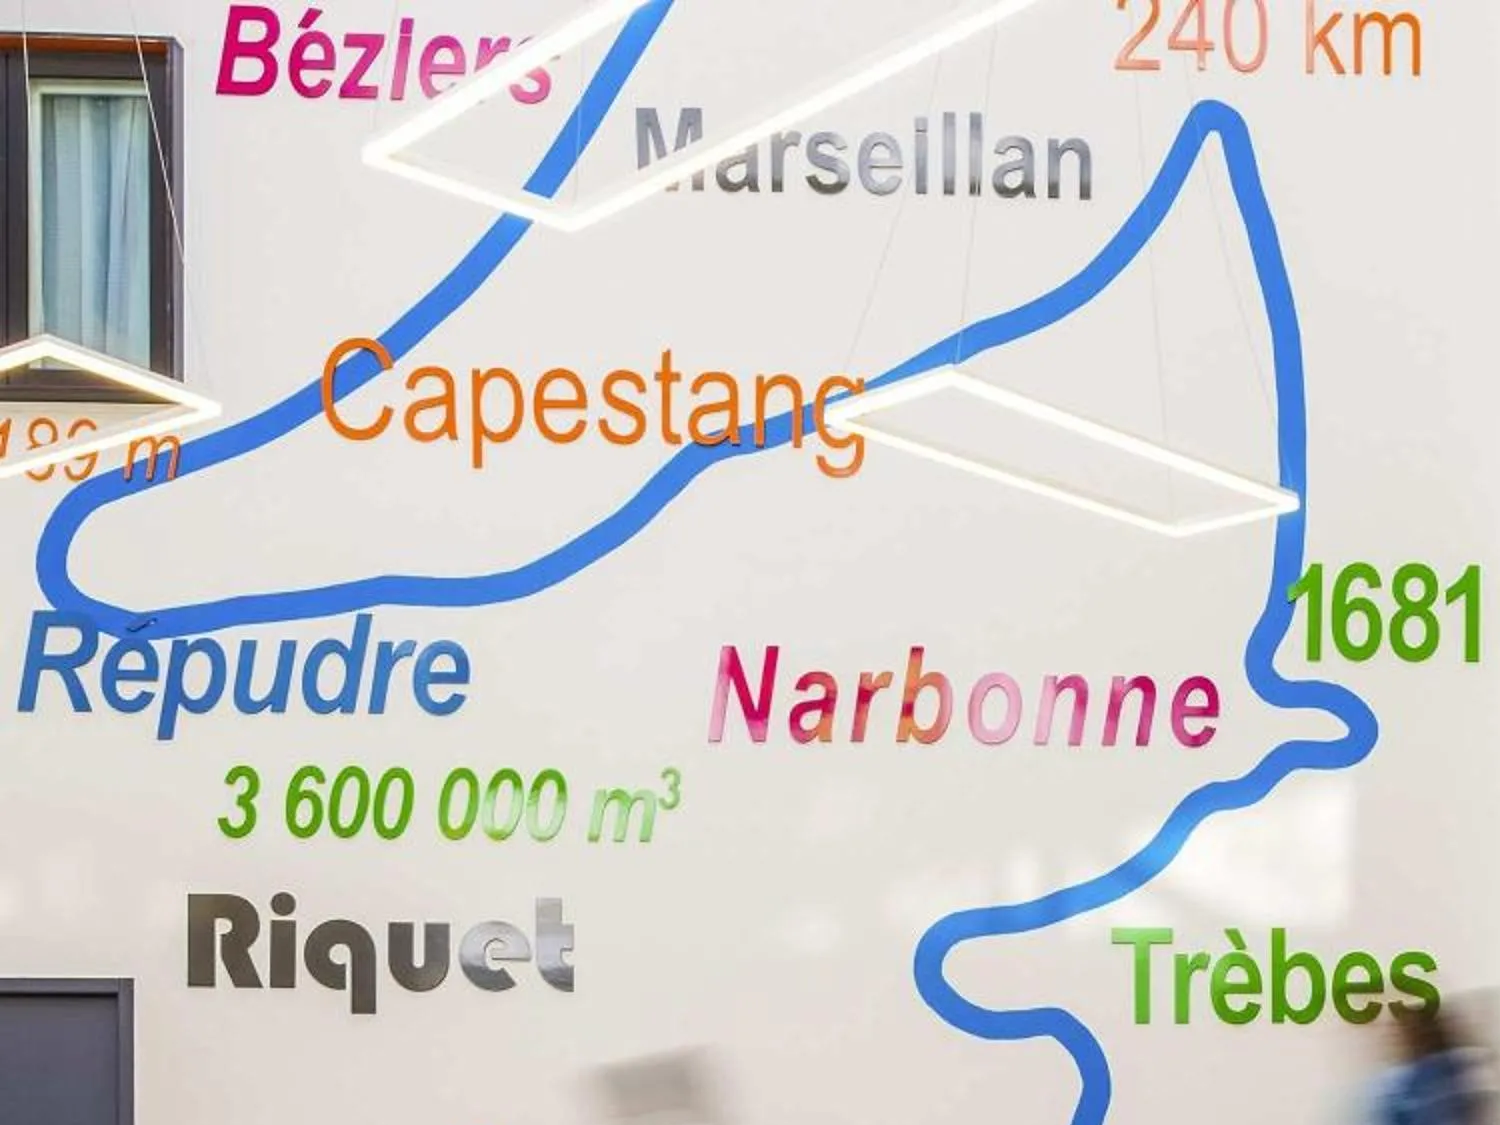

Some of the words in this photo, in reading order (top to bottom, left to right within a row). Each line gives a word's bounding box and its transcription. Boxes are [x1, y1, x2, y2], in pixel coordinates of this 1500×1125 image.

[216, 4, 560, 105] Béziers
[1114, 0, 1268, 72] 240
[1305, 0, 1422, 76] km
[635, 107, 1093, 201] Marseillan
[124, 435, 181, 480] m
[321, 337, 866, 479] Capestang
[1287, 562, 1481, 663] 1681
[17, 609, 471, 741] Répudre
[707, 645, 1221, 748] Narbonne
[217, 765, 261, 839] 3
[285, 766, 415, 840] 600
[438, 768, 568, 842] 000
[187, 891, 575, 1014] Riquet
[1111, 928, 1442, 1026] Trèbes
